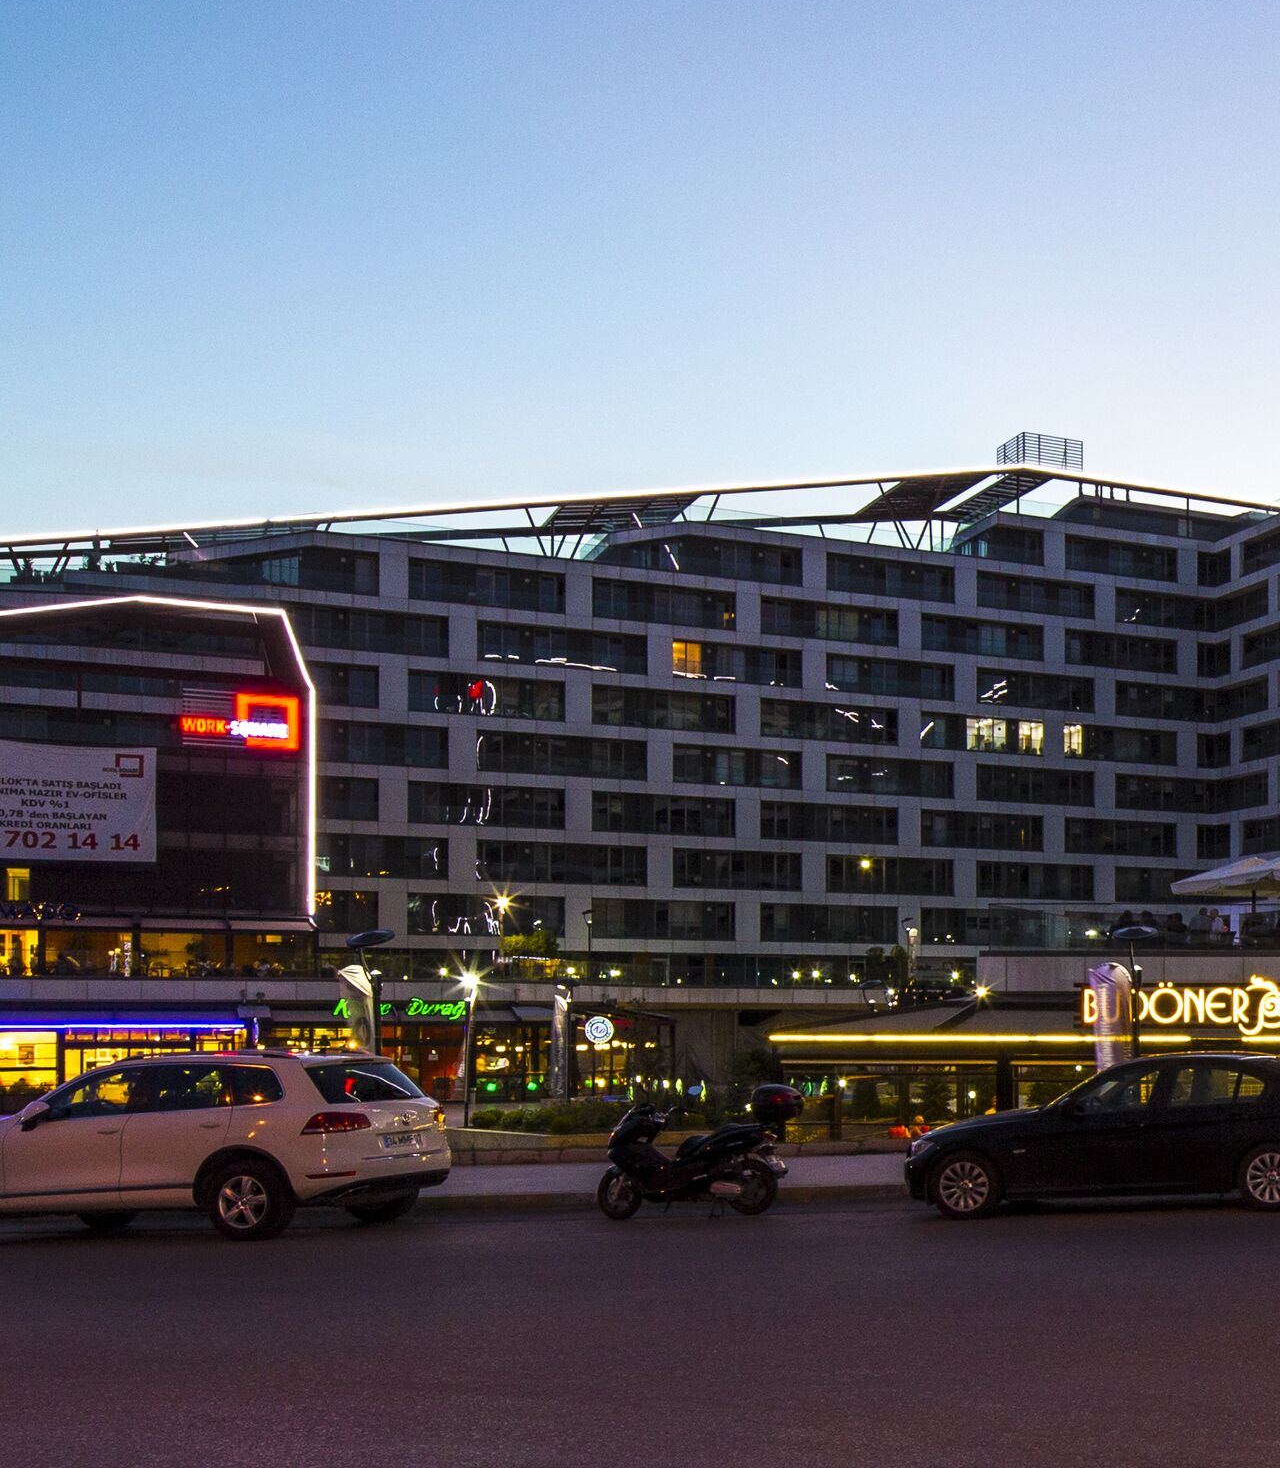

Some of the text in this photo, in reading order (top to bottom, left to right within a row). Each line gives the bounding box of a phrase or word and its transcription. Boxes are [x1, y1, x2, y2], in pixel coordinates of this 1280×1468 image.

[0, 777, 122, 791] LOK'TA SATIŞ BAŞLADI
[28, 788, 63, 798] HAZIR
[21, 798, 70, 809] KDV %1
[52, 812, 108, 822] BAŞLAYAN
[36, 821, 92, 830] ORANLARI
[4, 830, 141, 851] 702 14 14
